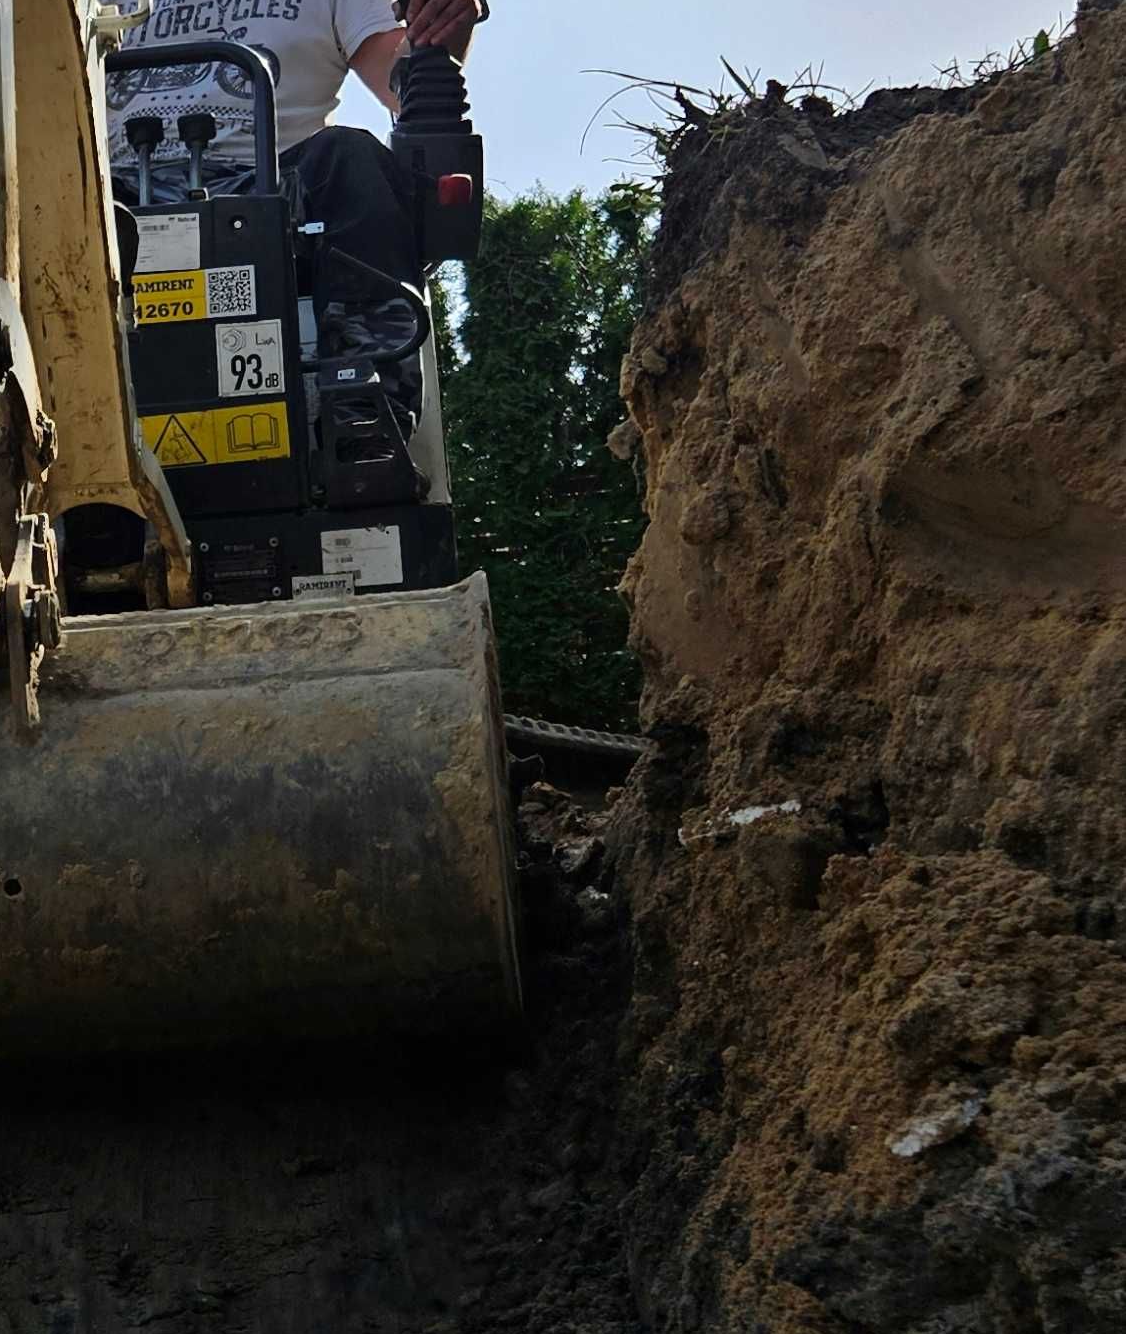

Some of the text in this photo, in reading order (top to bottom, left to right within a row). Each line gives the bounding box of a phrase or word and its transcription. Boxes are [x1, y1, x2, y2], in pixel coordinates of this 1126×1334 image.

[136, 278, 195, 293] AMIRENT
[230, 354, 279, 391] 93 dB
